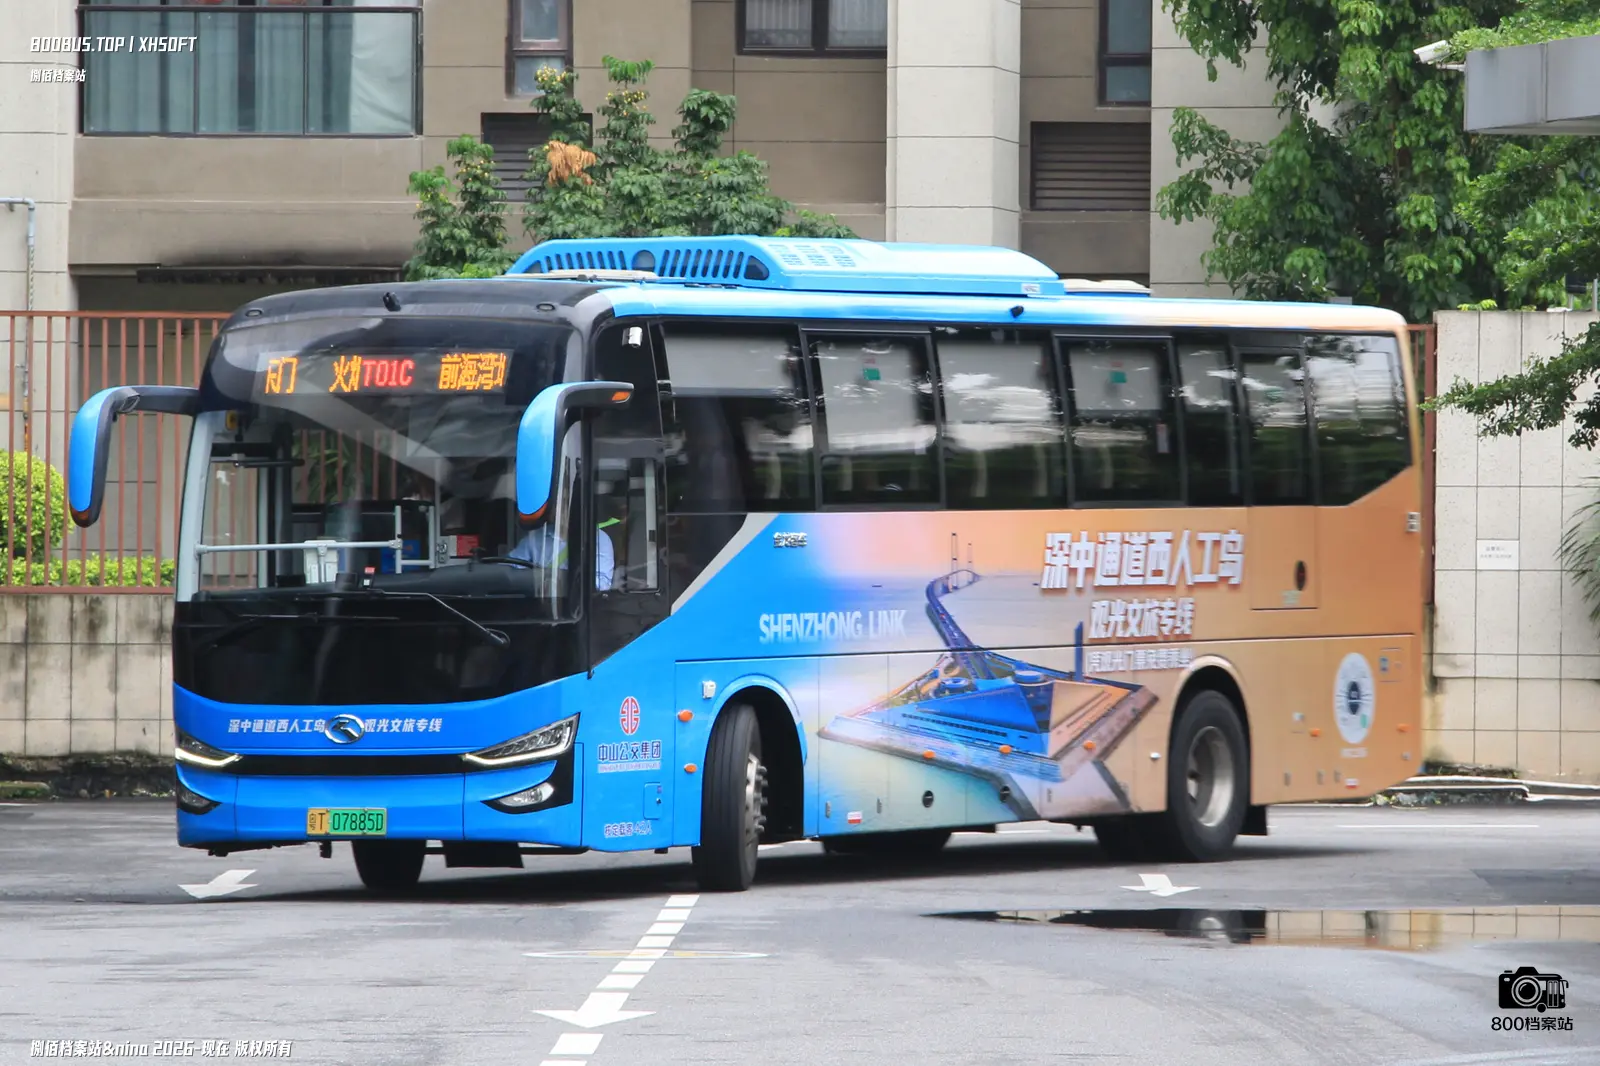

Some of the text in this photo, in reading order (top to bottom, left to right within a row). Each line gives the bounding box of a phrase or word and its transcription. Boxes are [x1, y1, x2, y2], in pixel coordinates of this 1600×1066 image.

[362, 359, 415, 387] T01C
[1041, 529, 1245, 589] 深中通道西人工岛
[759, 609, 907, 644] SHENZHONG LINK
[1088, 597, 1195, 640] 观光文旅专线
[228, 718, 443, 733] 深中通道西人工岛 观光文旅专线
[598, 740, 662, 761] 中山公交集团
